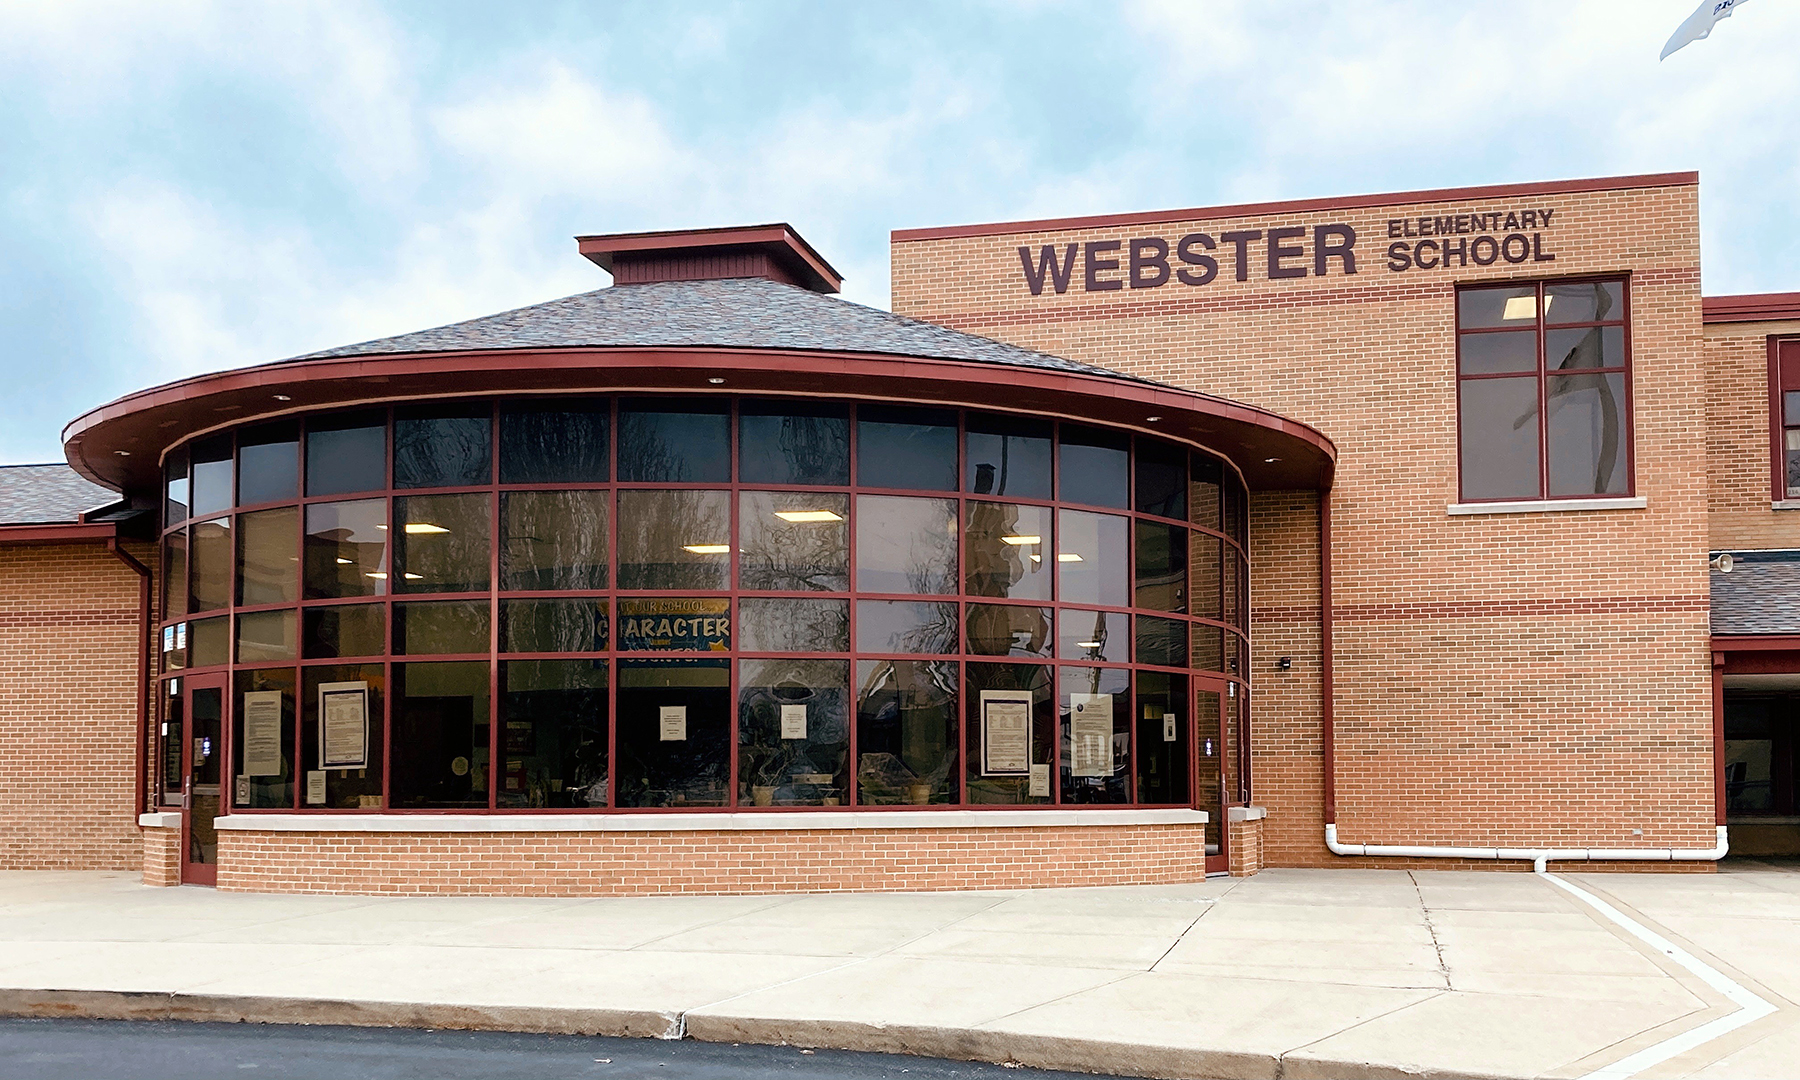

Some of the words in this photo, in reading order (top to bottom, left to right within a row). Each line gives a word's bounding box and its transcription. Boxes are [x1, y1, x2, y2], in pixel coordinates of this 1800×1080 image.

[1388, 209, 1554, 238] ELEMENTARY
[1018, 225, 1358, 295] WEBSTER
[1387, 233, 1555, 272] SCHOOL
[635, 600, 657, 612] OUR
[596, 617, 730, 639] CARACTER
